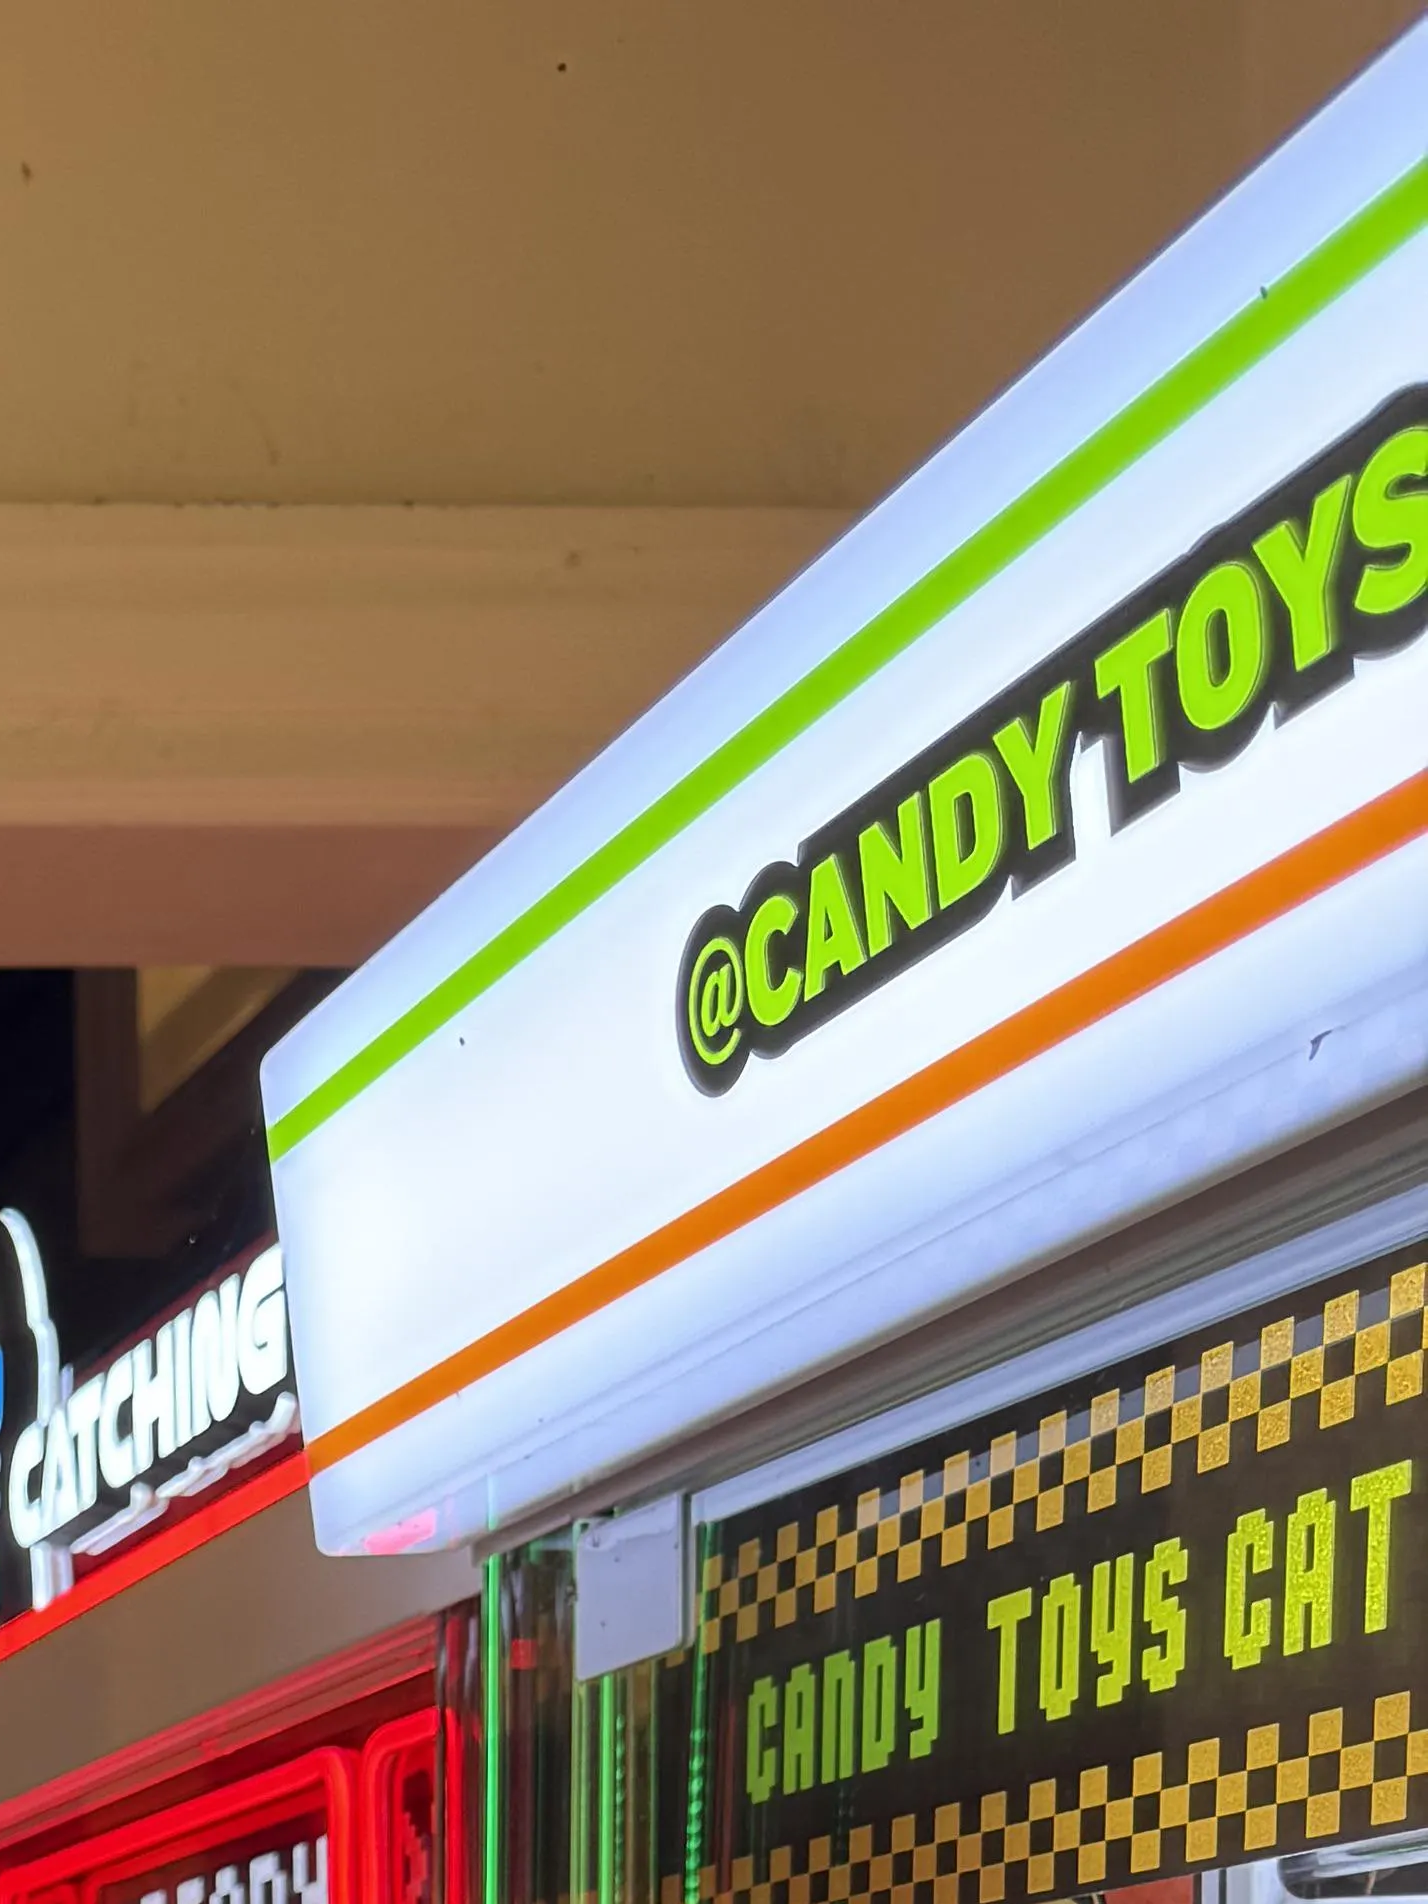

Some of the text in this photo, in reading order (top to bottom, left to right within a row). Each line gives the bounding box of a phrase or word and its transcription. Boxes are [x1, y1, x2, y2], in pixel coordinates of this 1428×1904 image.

[687, 425, 1428, 1066] @CANDY TOYS
[8, 1242, 289, 1550] CATCHING
[746, 1458, 1413, 1805] CANDY TOYS CAT
